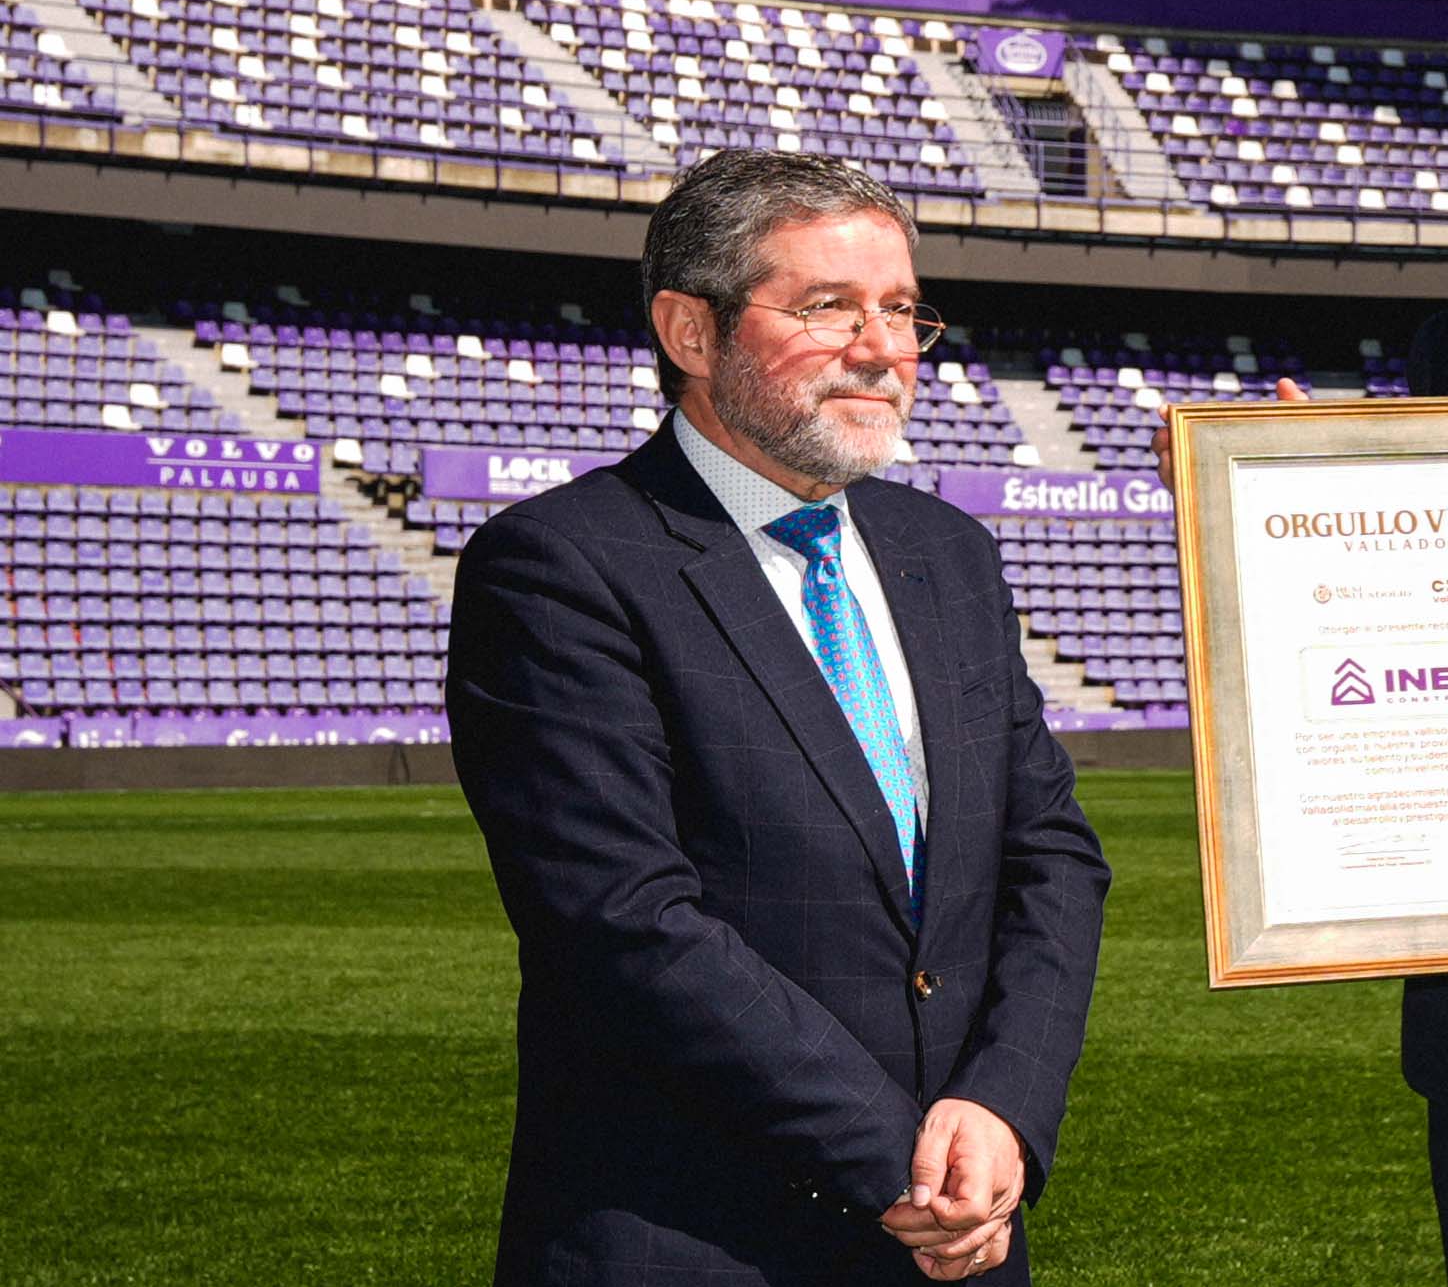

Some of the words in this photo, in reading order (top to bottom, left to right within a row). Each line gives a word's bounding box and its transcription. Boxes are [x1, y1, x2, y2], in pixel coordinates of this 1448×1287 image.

[146, 436, 316, 463] VOLVO
[159, 465, 301, 491] PALAUSA
[487, 454, 574, 483] LOCK
[1003, 473, 1119, 512] Estrella
[1263, 510, 1418, 540] ORGULLO
